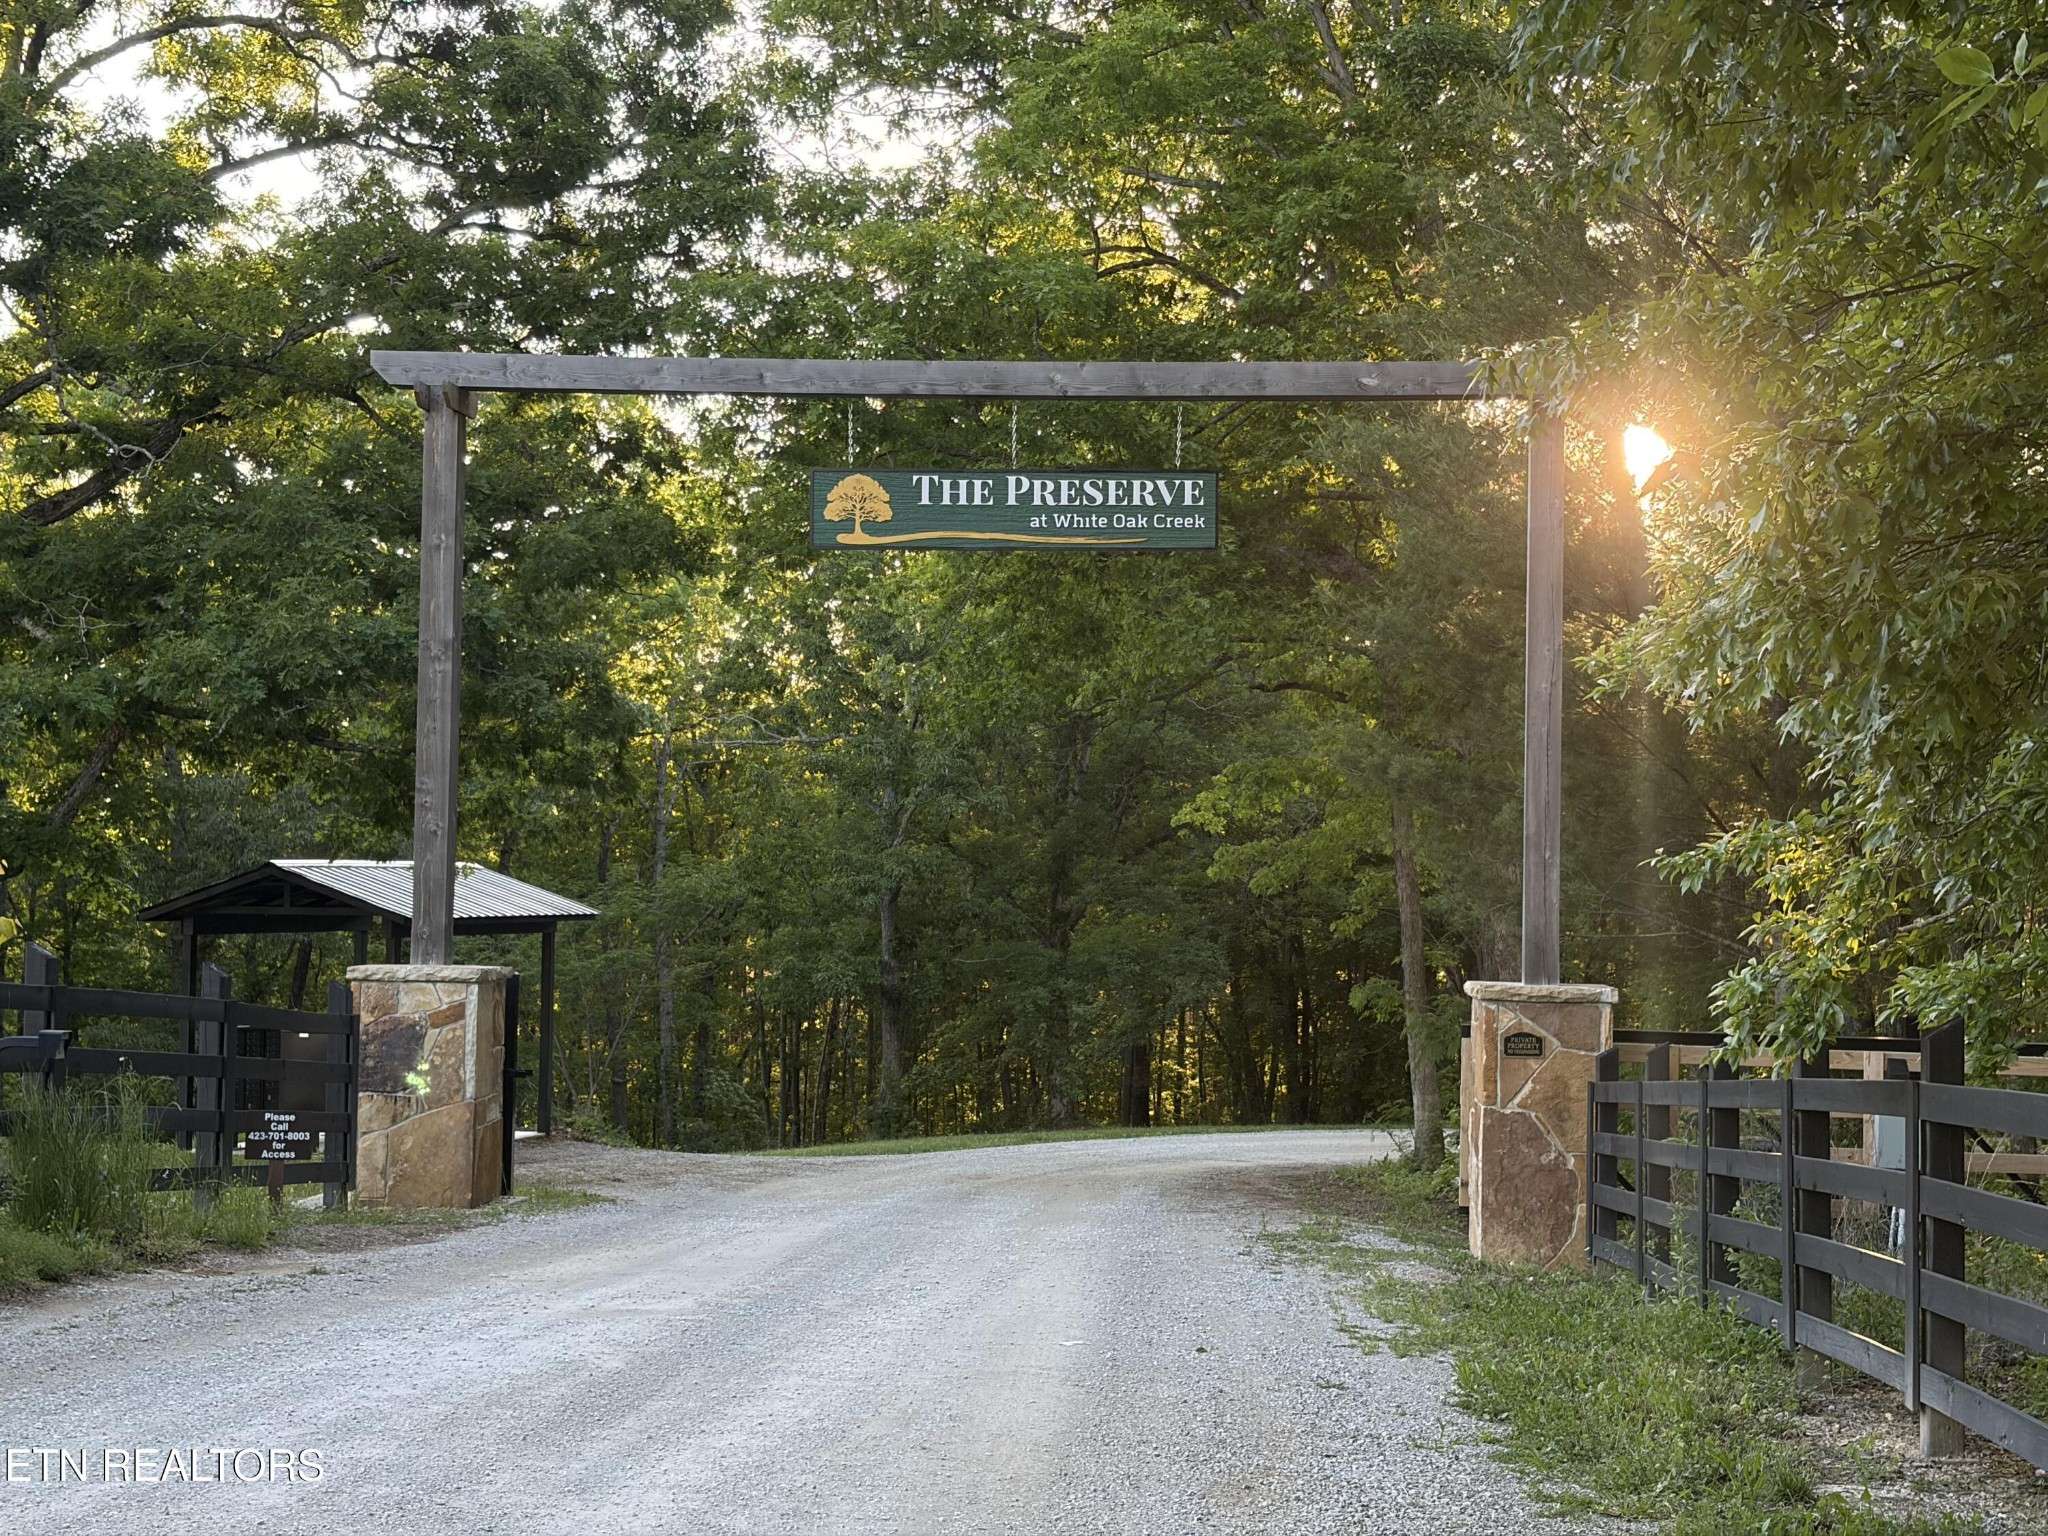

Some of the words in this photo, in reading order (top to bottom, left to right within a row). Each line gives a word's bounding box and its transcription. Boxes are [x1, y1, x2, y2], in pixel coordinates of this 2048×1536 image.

[912, 474, 993, 505] THE
[1005, 475, 1204, 506] PRESERVE
[1029, 514, 1048, 528] at
[1054, 513, 1107, 529] White
[1113, 513, 1148, 529] Oak
[1153, 513, 1205, 529] Creek
[264, 1113, 296, 1121] Please
[270, 1123, 289, 1131] Call
[248, 1132, 310, 1140] 423-701-8003
[272, 1141, 286, 1149] for
[261, 1150, 296, 1158] Access
